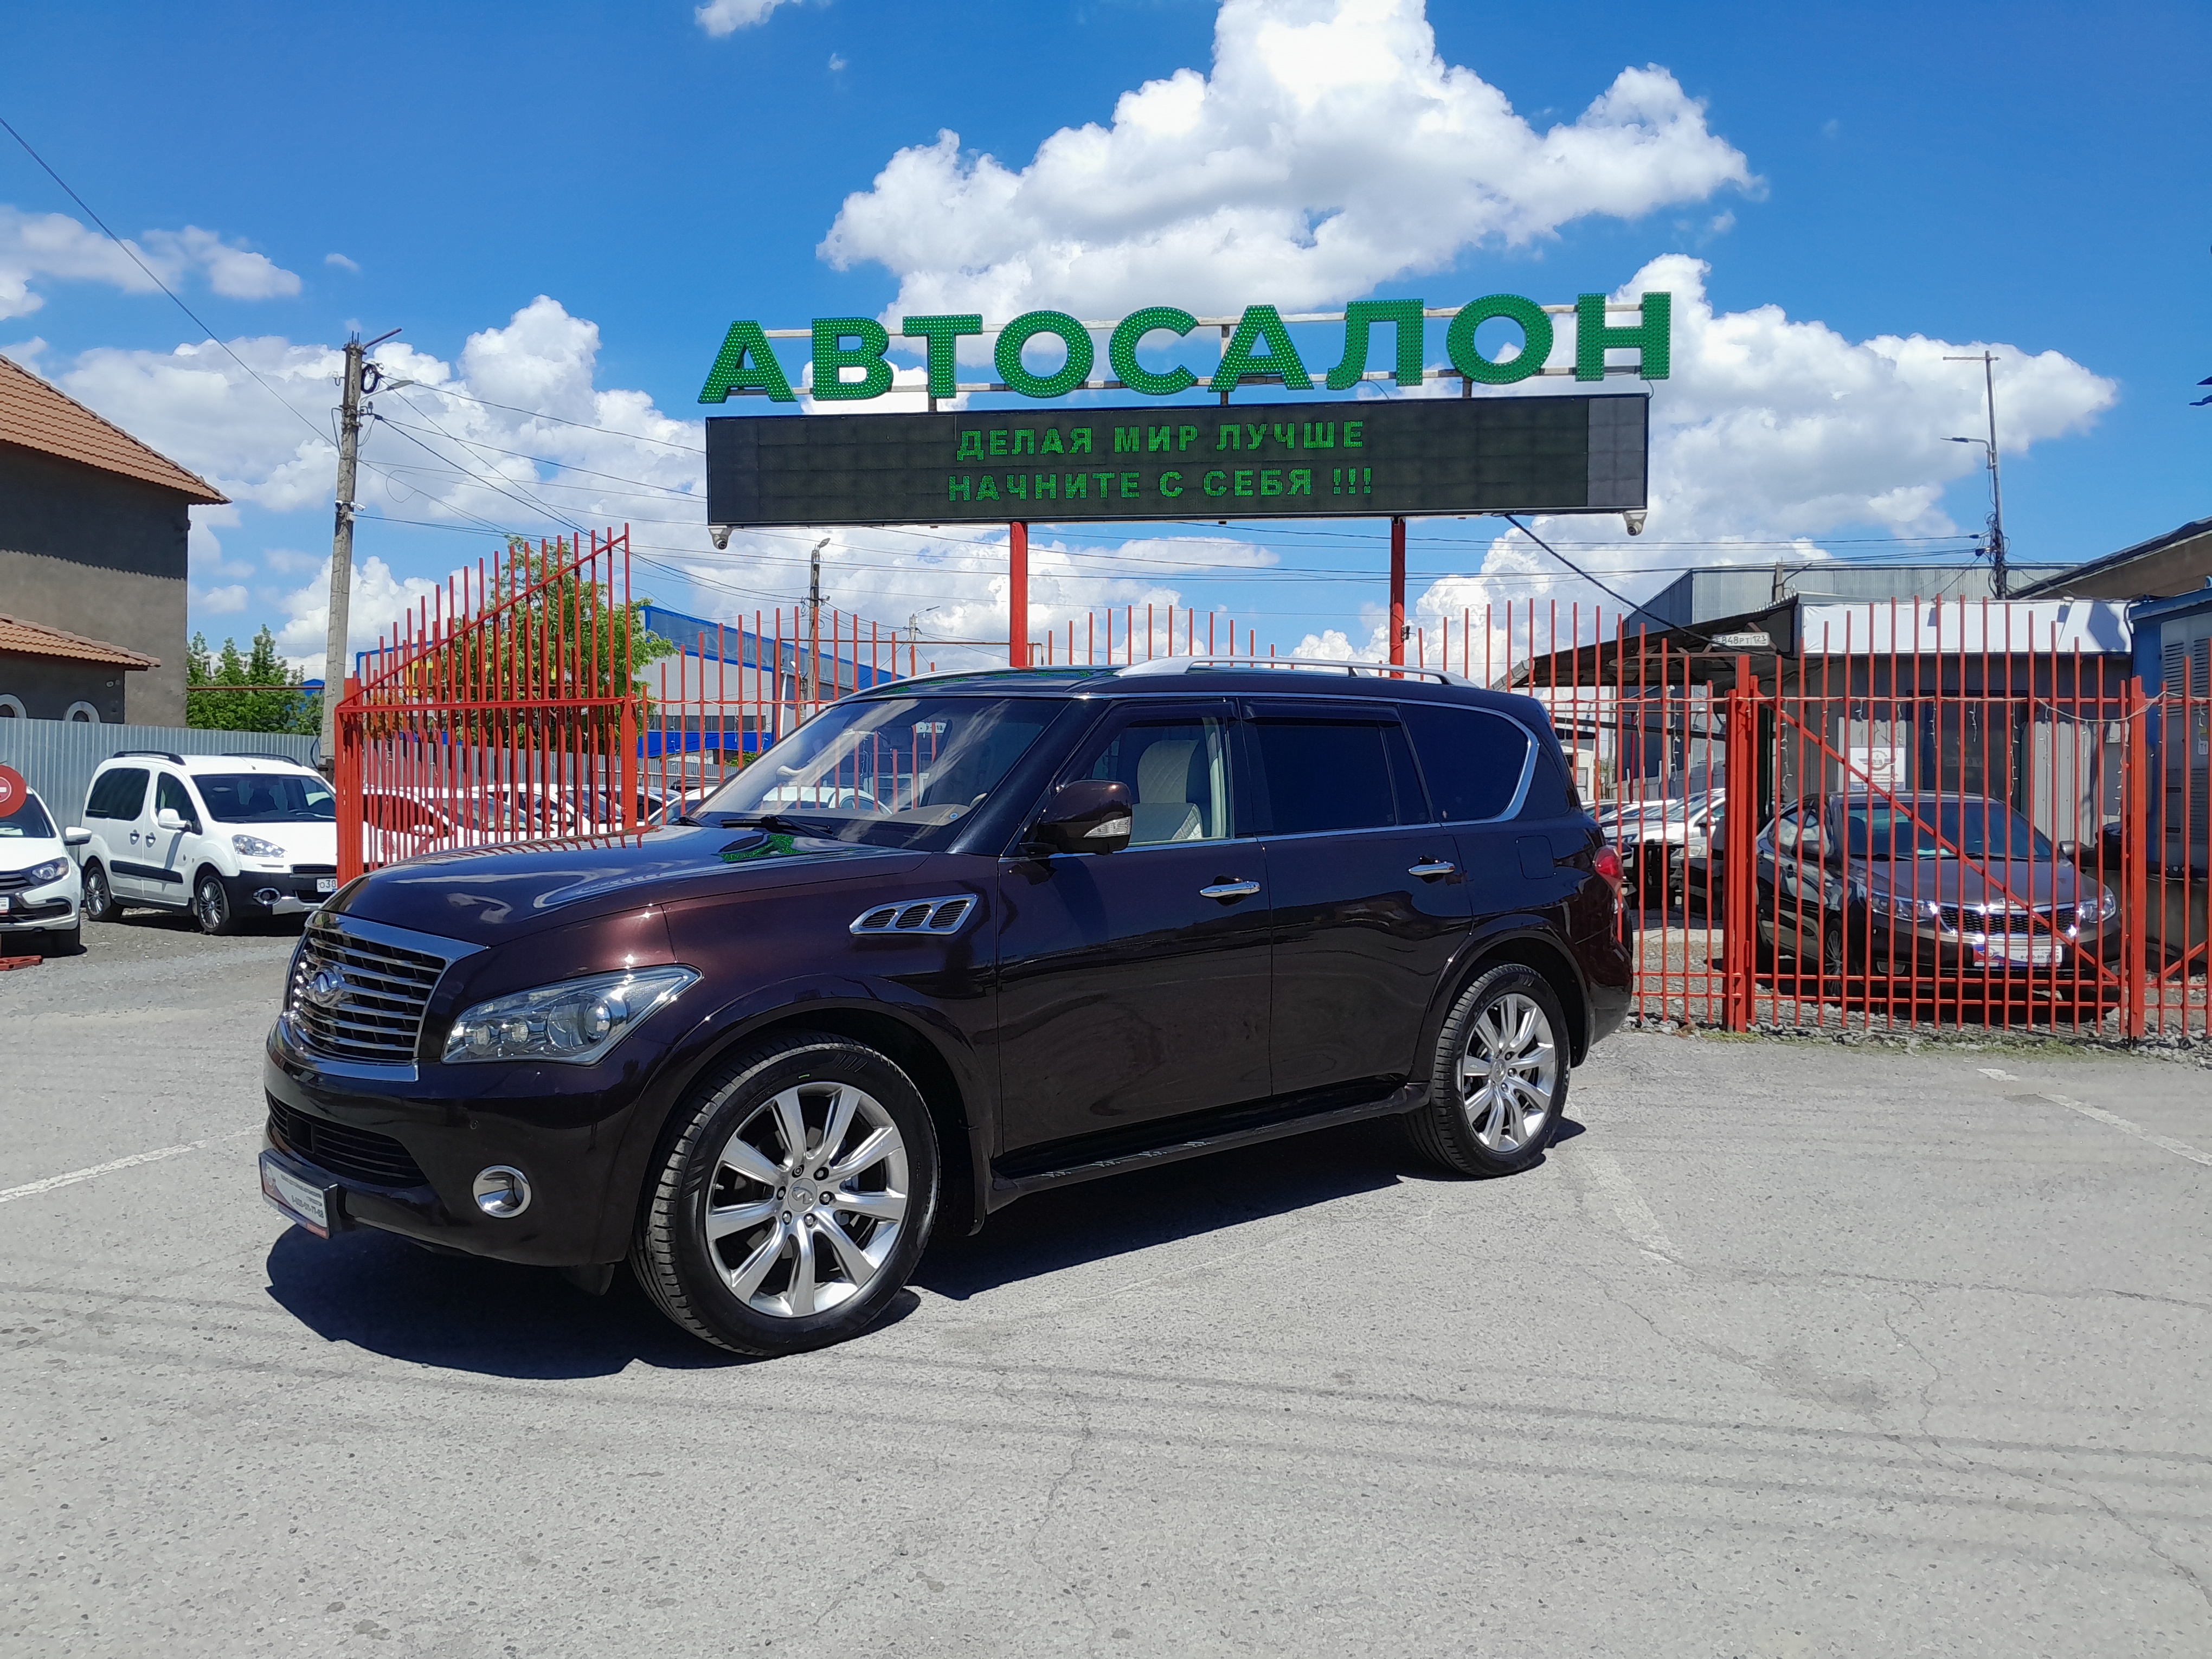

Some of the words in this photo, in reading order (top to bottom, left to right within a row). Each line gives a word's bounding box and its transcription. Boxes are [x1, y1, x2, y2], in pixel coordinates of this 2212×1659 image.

[698, 292, 1671, 404] АВТОСАЛОН
[956, 427, 1092, 461] ДЕЛАЯ
[1114, 425, 1198, 454] МИР
[1216, 421, 1364, 451] ЛУЧШЕ
[949, 472, 1140, 501] НАЧНИТЕ
[1159, 471, 1183, 498] С
[1203, 468, 1311, 497] СЕБЯ
[1333, 467, 1372, 494] !!!
[319, 879, 337, 889] О38
